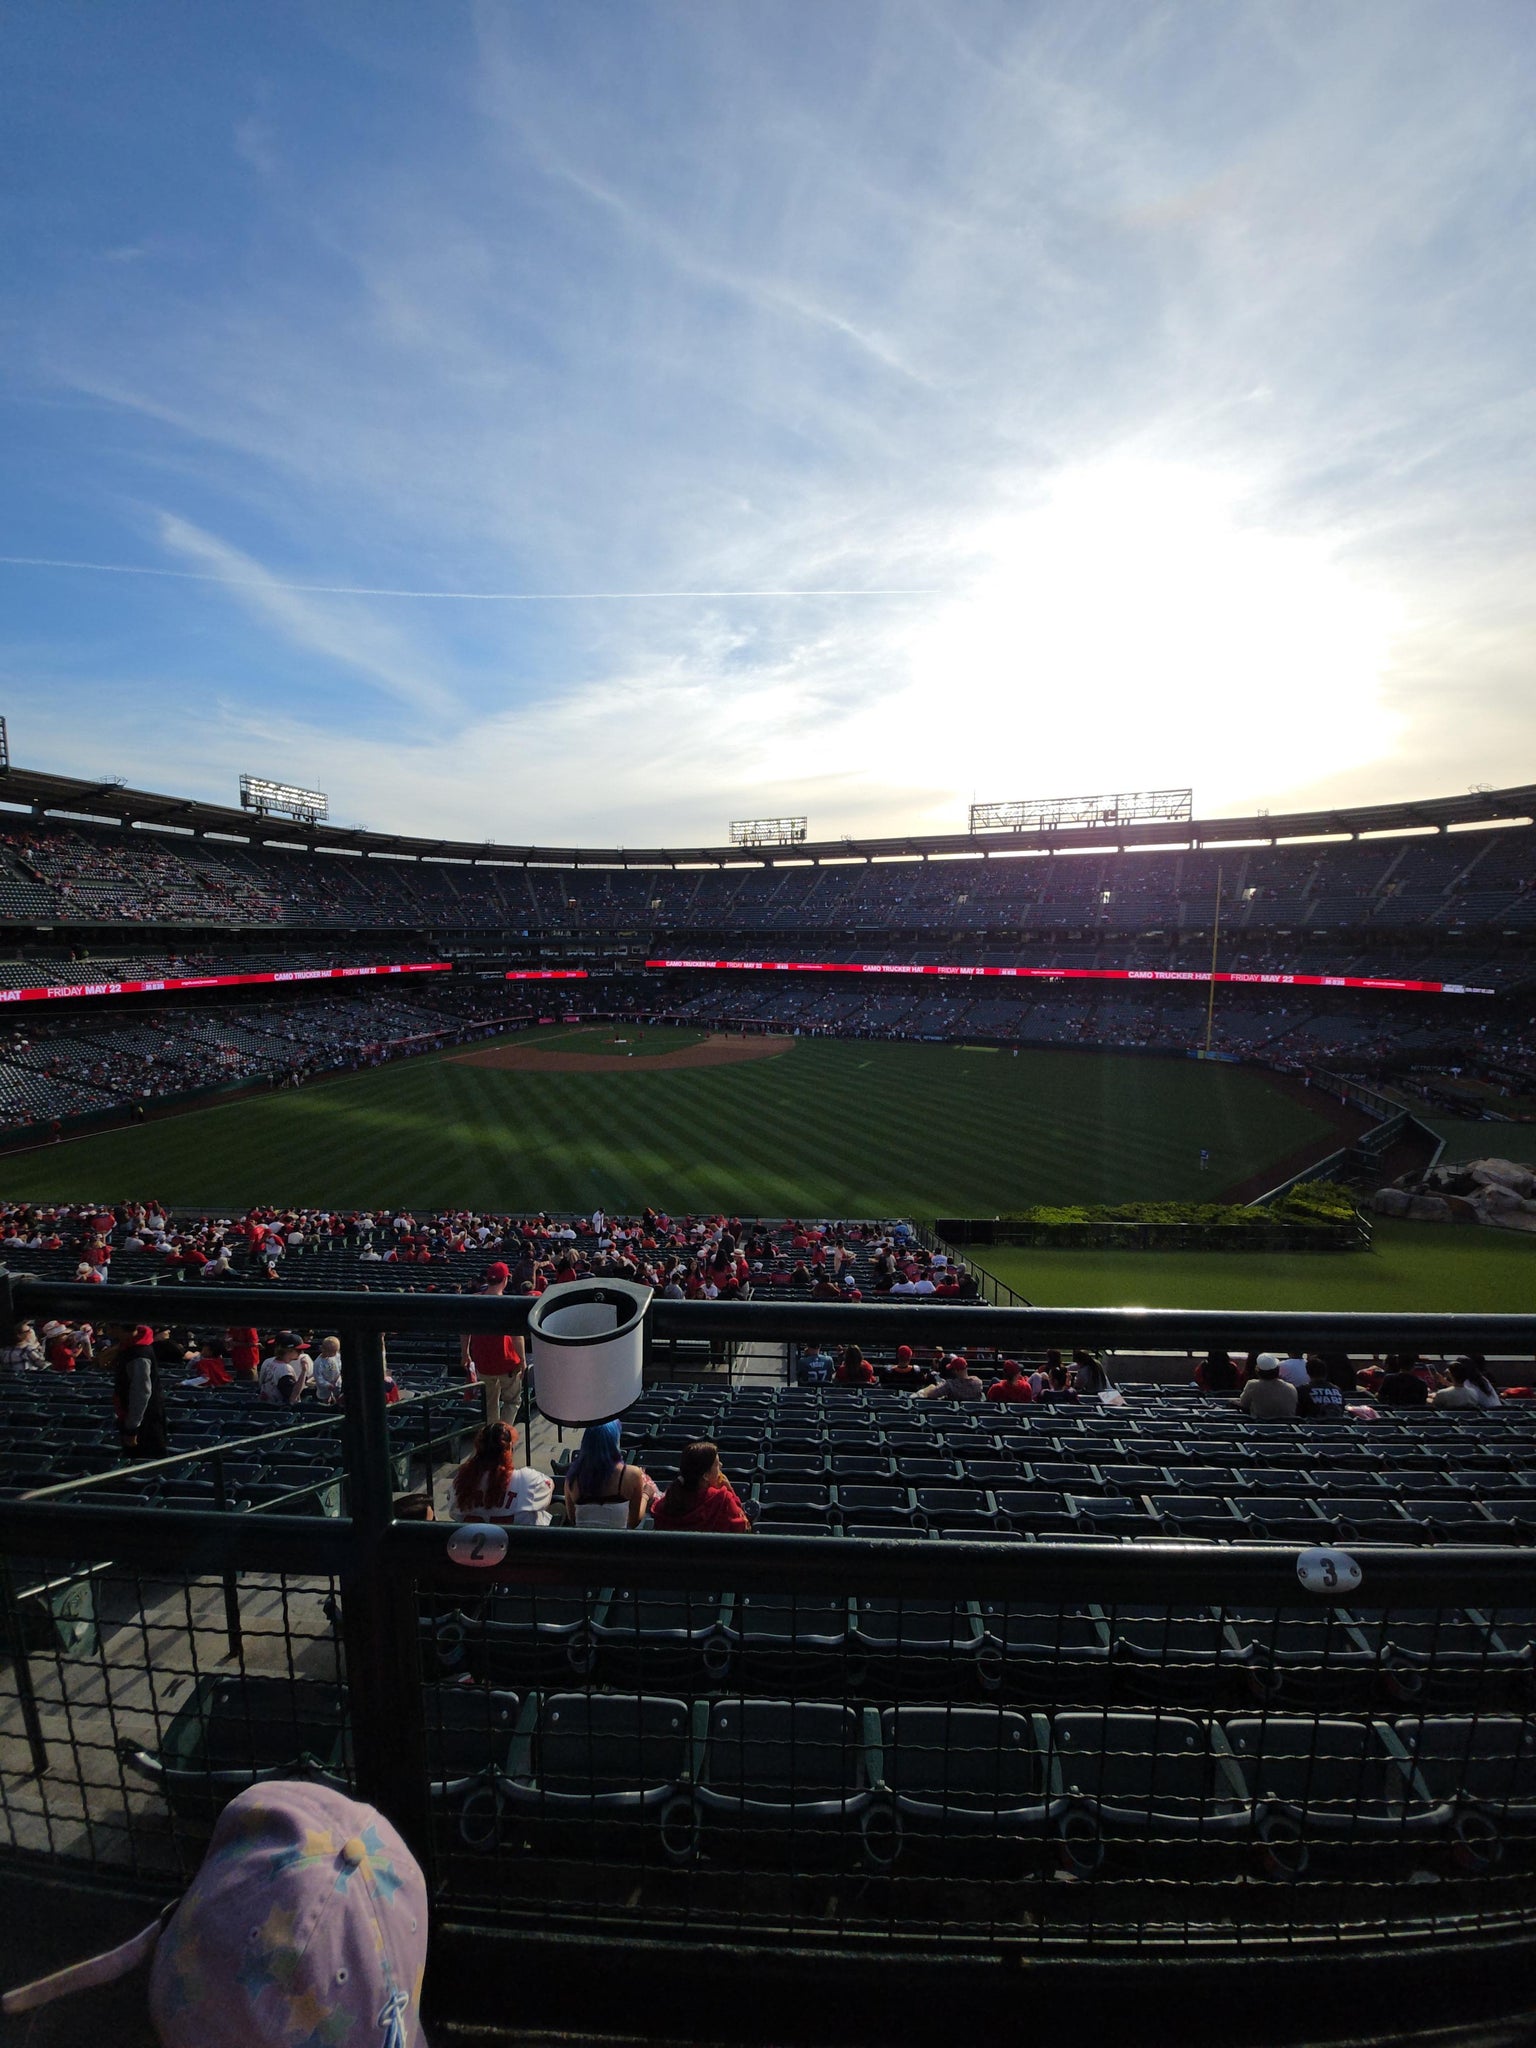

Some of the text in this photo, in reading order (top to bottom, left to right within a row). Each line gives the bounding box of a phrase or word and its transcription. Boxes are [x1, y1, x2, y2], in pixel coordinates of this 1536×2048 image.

[274, 972, 293, 981] CAMO
[294, 971, 321, 980] TRUCKER
[321, 970, 332, 978] HAT
[342, 968, 359, 976] FRIDAY
[359, 967, 370, 975] MAY
[882, 965, 911, 973] TRUCKER
[959, 967, 975, 975] MAY
[1128, 971, 1294, 983] CAMO TRUCKER HAT FRIDAY MAY 22
[0, 984, 122, 1001] HAT FRIDAY MAY 22
[1311, 1388, 1341, 1396] STAR
[325, 1493, 334, 1508] 4
[470, 1531, 486, 1561] 2
[1319, 1557, 1337, 1587] 3
